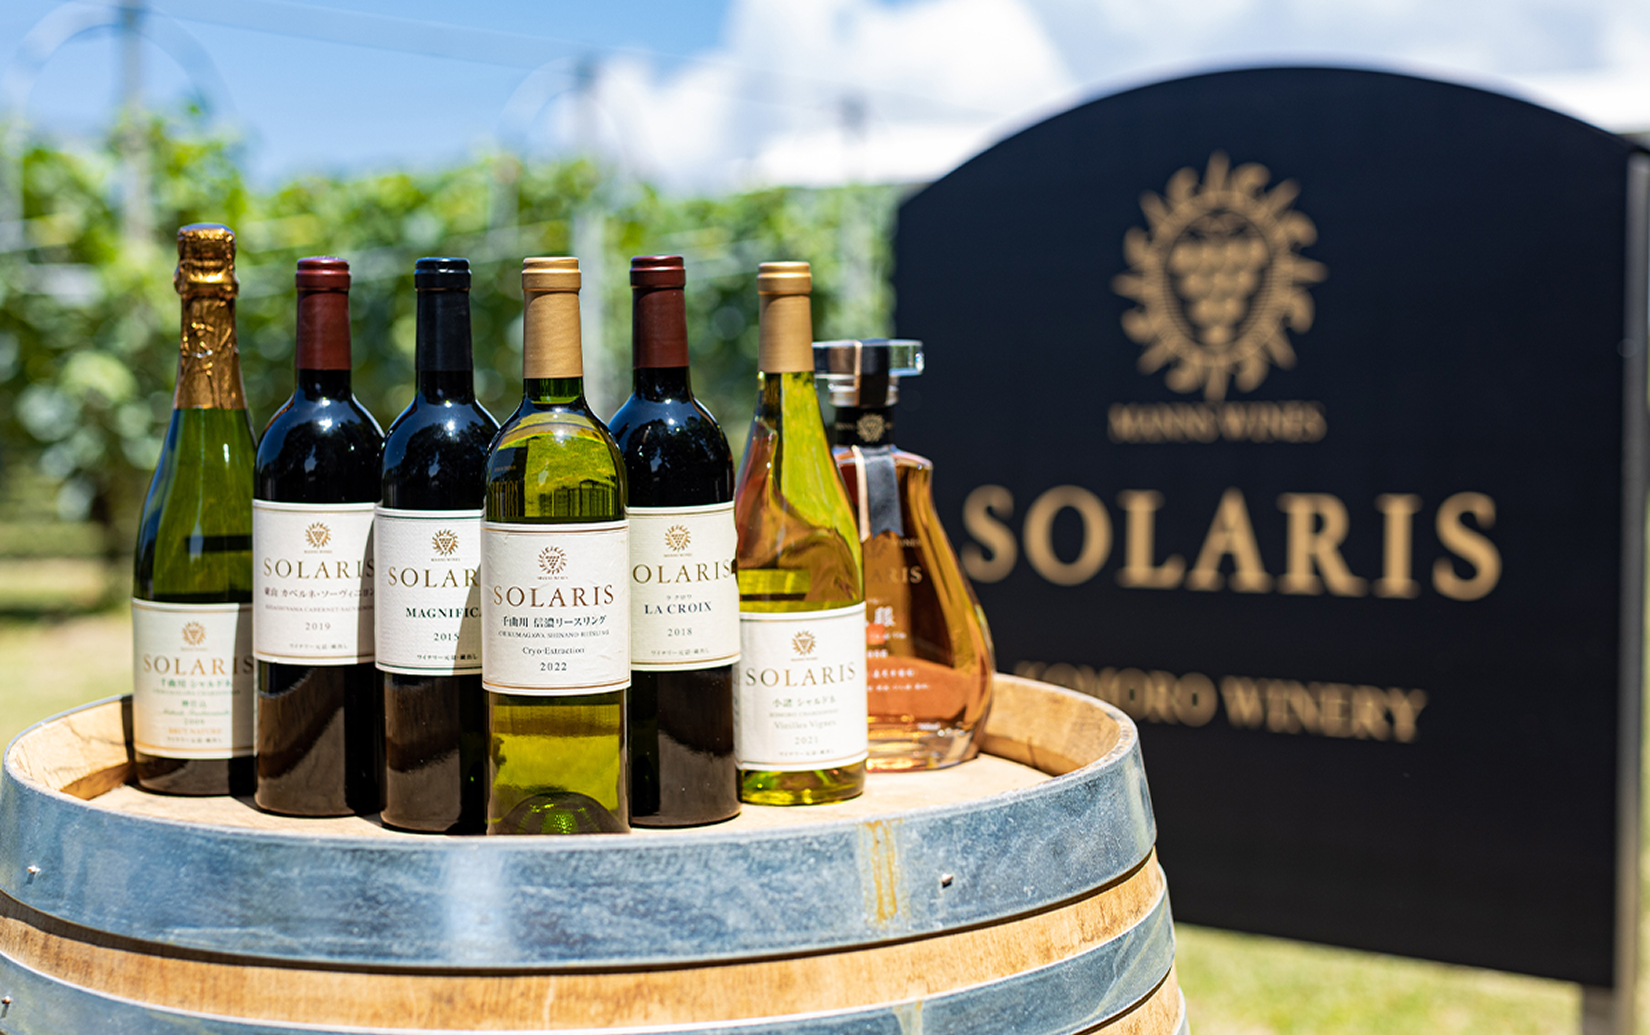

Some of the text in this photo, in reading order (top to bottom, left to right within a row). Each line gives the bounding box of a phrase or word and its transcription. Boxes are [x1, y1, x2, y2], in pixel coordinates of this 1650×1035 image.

[960, 484, 1502, 601] SOLARIS
[263, 557, 374, 579] SOLARIS
[493, 584, 614, 608] SOLARIS
[644, 602, 712, 614] LA CROIX
[305, 622, 331, 631] 2019
[434, 632, 460, 642] 2015
[667, 627, 692, 637] 2018
[143, 654, 254, 676] SOLARIS
[540, 662, 567, 671] 2022
[745, 662, 856, 688] SOLARIS
[1219, 674, 1427, 743] WINERY
